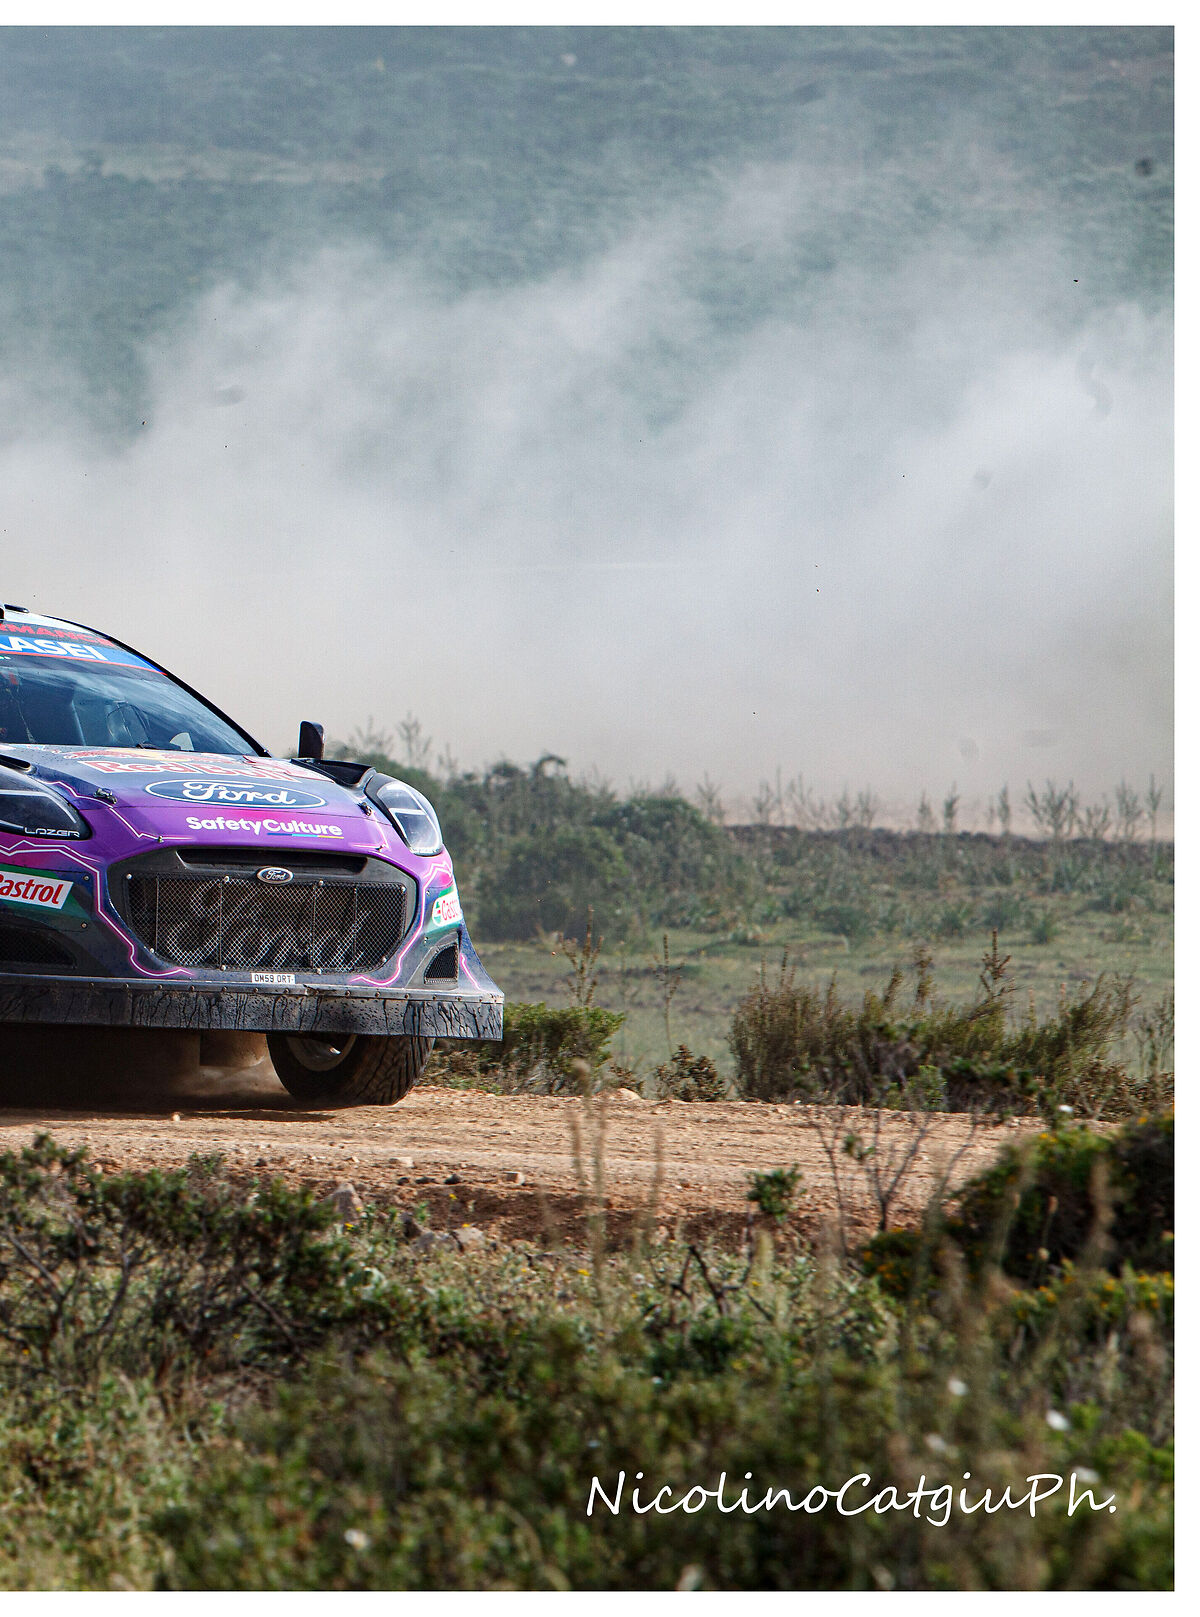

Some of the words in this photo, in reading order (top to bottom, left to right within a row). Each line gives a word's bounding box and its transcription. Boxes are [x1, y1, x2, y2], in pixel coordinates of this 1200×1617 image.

[182, 781, 297, 805] Ford
[24, 826, 80, 838] LAZER
[266, 869, 287, 882] Ford
